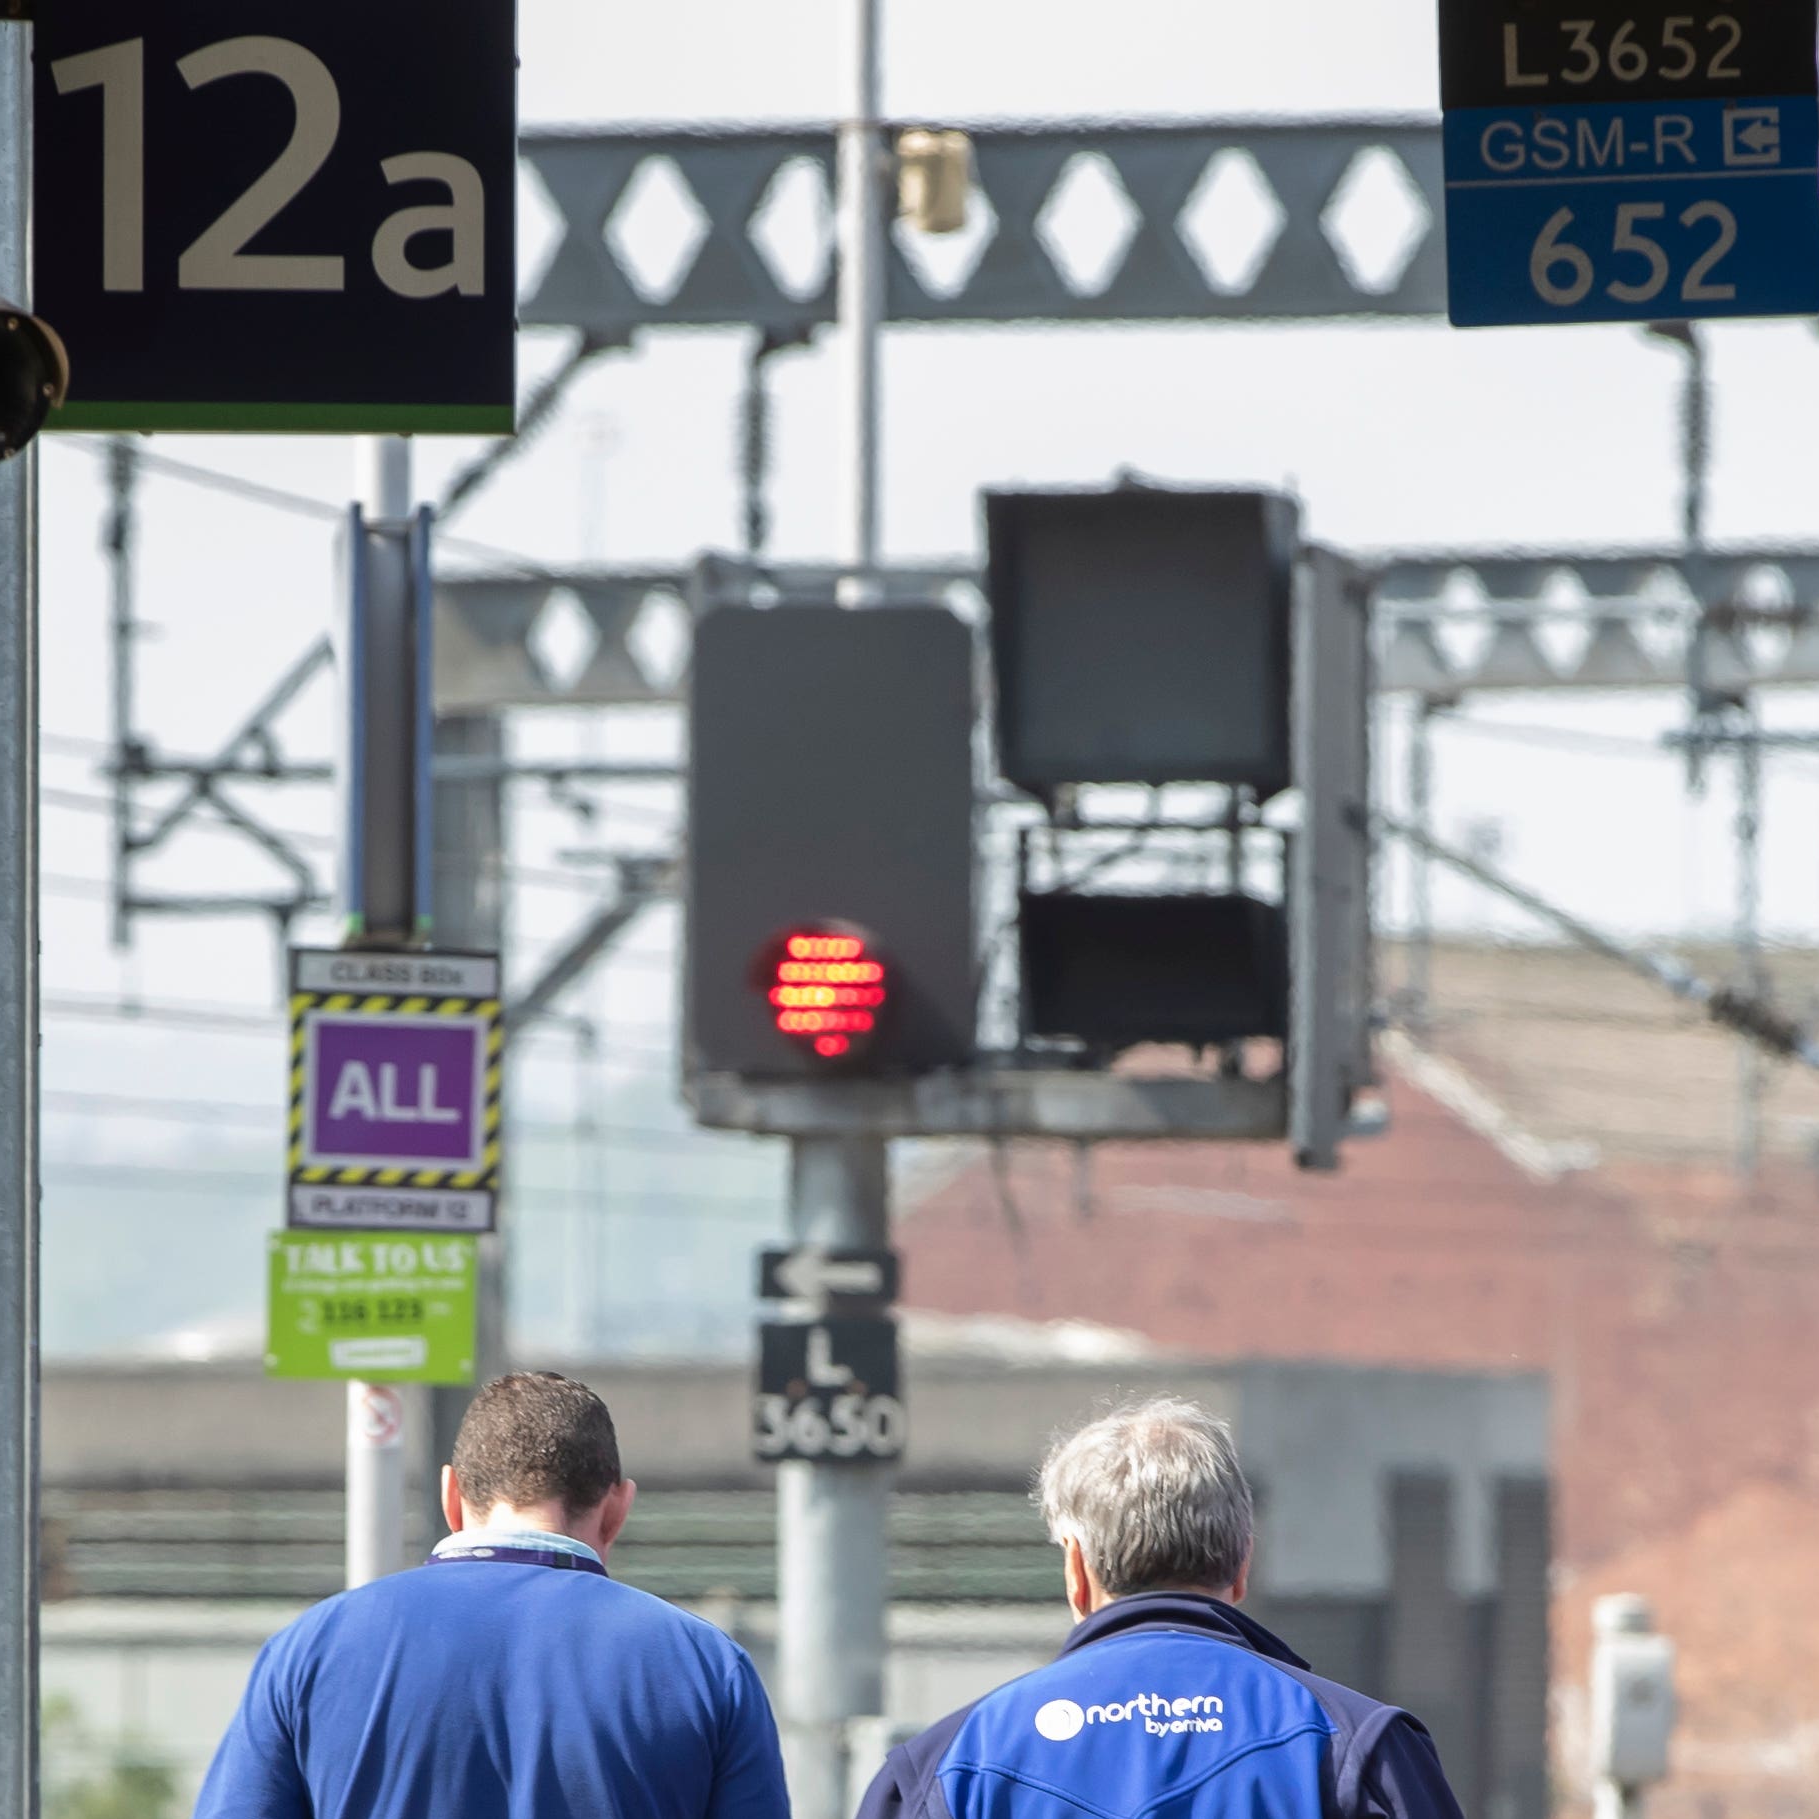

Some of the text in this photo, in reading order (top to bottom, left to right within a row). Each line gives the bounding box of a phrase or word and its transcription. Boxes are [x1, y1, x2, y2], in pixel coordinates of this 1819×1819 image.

[1503, 15, 1742, 87] L3652
[51, 36, 486, 298] 12a
[1481, 115, 1697, 172] GSM-R
[1529, 200, 1738, 306] 652
[331, 959, 411, 983] CLASS
[328, 1060, 461, 1124] ALL
[284, 1241, 465, 1274] TALK TO US
[805, 1326, 855, 1387] L
[754, 1393, 907, 1457] 3650
[1085, 1692, 1224, 1725] northern
[1145, 1716, 1223, 1738] by arriva
